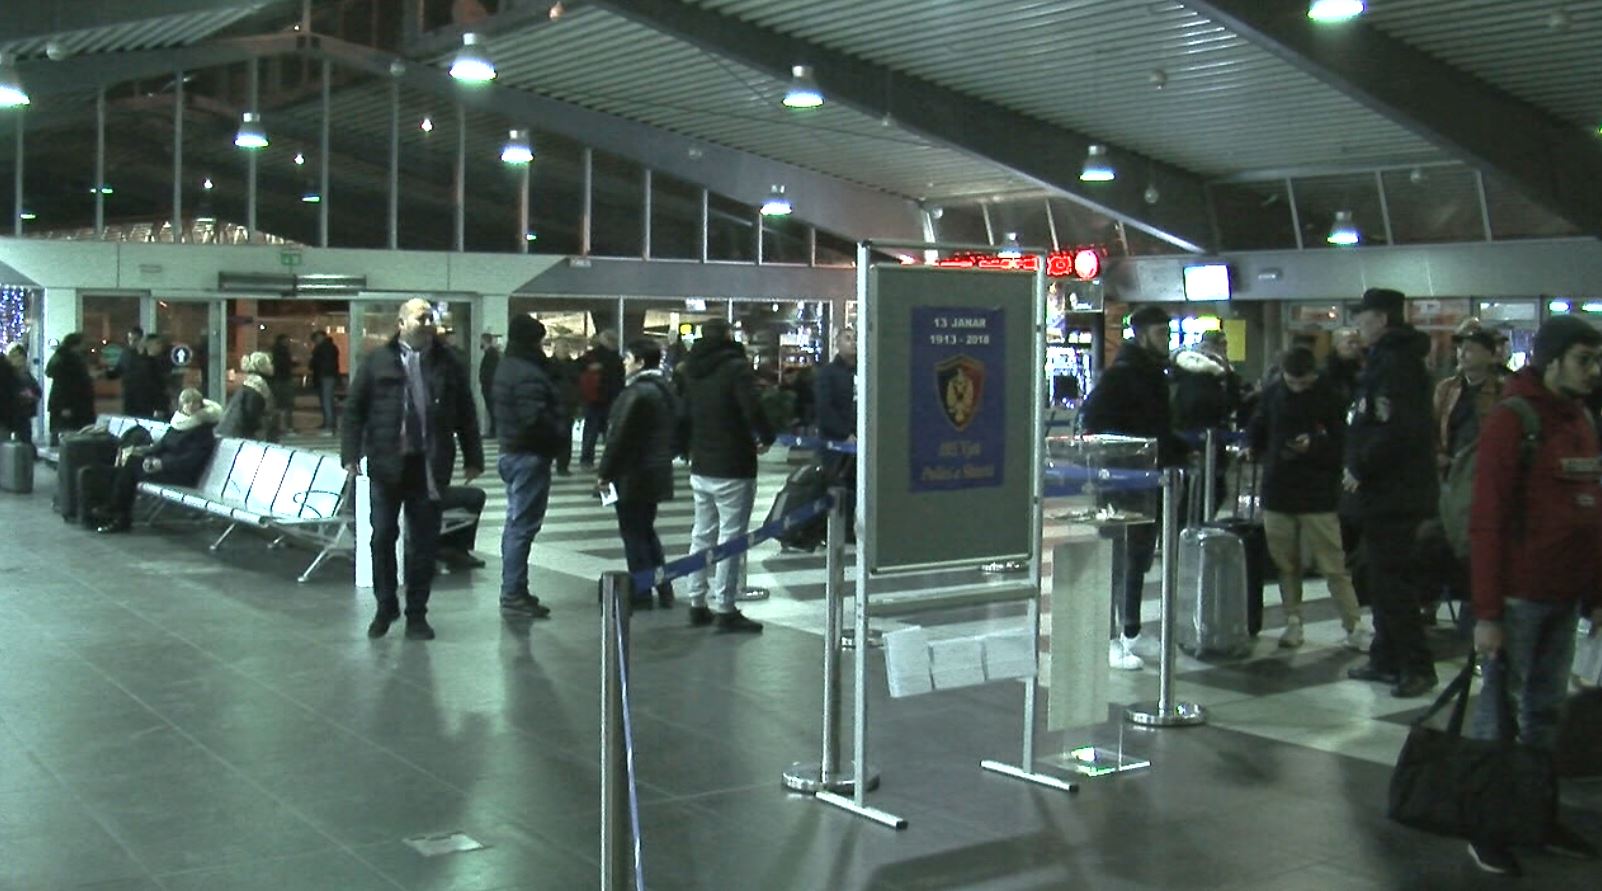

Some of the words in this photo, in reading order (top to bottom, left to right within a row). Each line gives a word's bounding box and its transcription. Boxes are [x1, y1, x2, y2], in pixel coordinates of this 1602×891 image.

[934, 318, 948, 328] 13
[951, 318, 986, 328] JANAR
[930, 335, 957, 345] 1913
[966, 334, 990, 345] 2018
